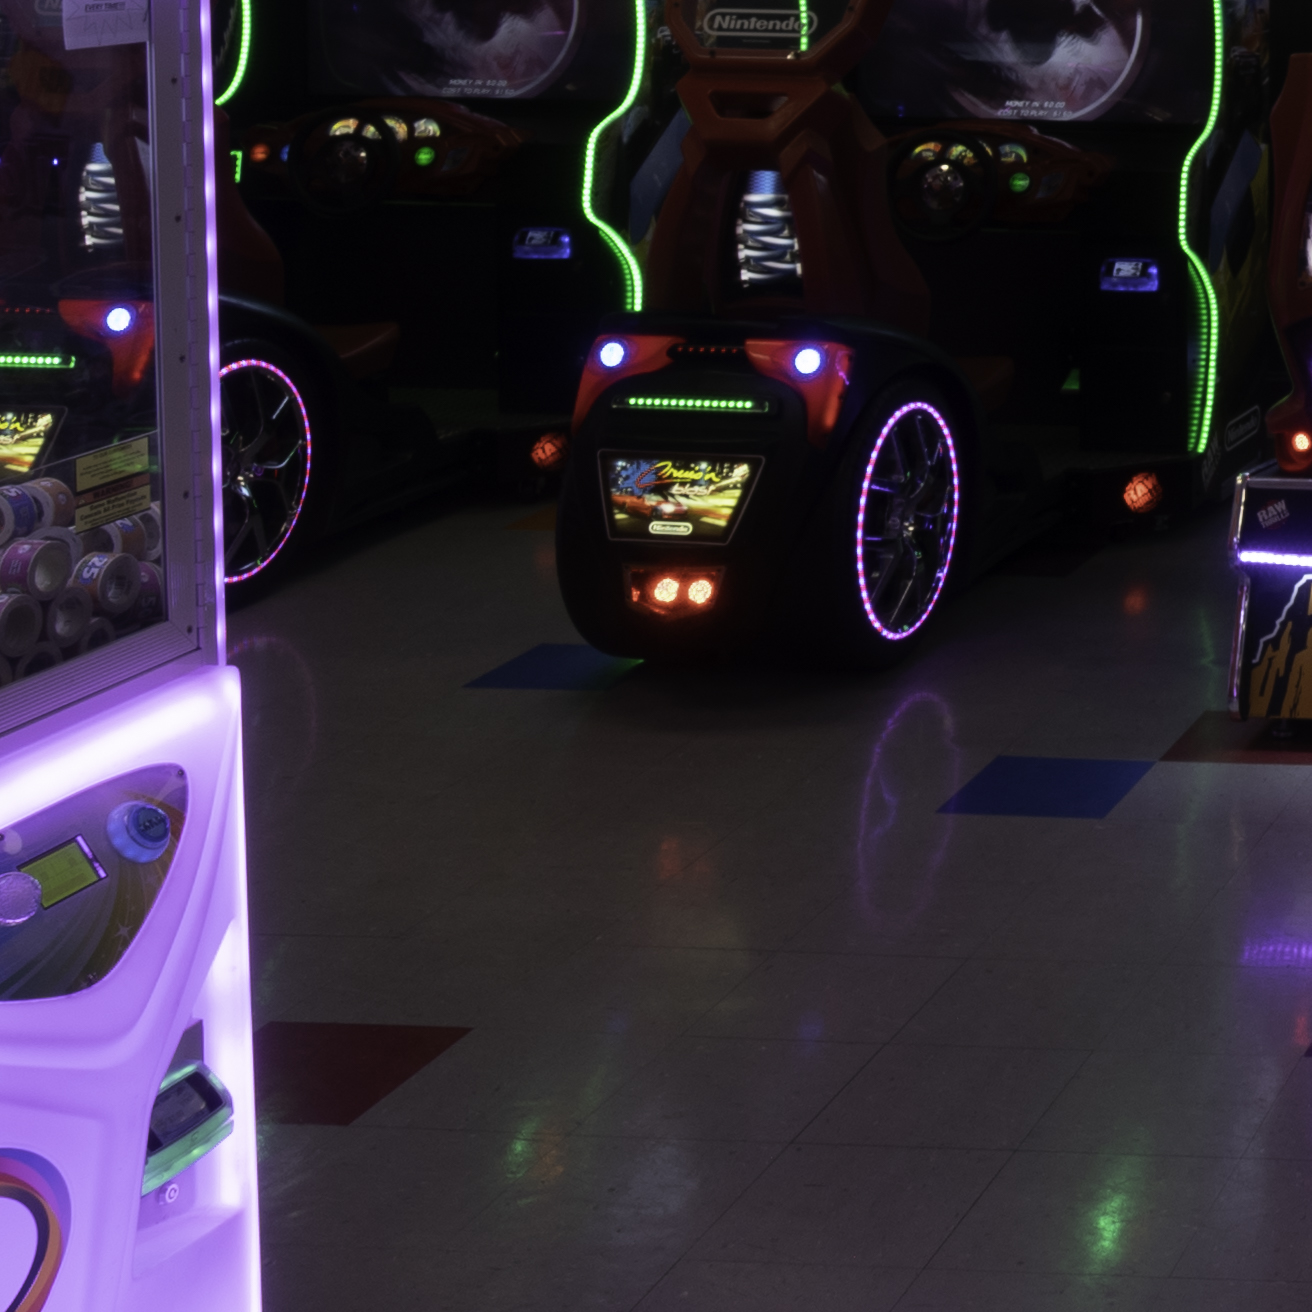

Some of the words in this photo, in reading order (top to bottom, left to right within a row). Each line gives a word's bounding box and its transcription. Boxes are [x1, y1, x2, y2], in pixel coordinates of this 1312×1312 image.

[713, 14, 810, 31] Nintendo
[670, 482, 716, 496] blast
[1257, 499, 1287, 522] RAW
